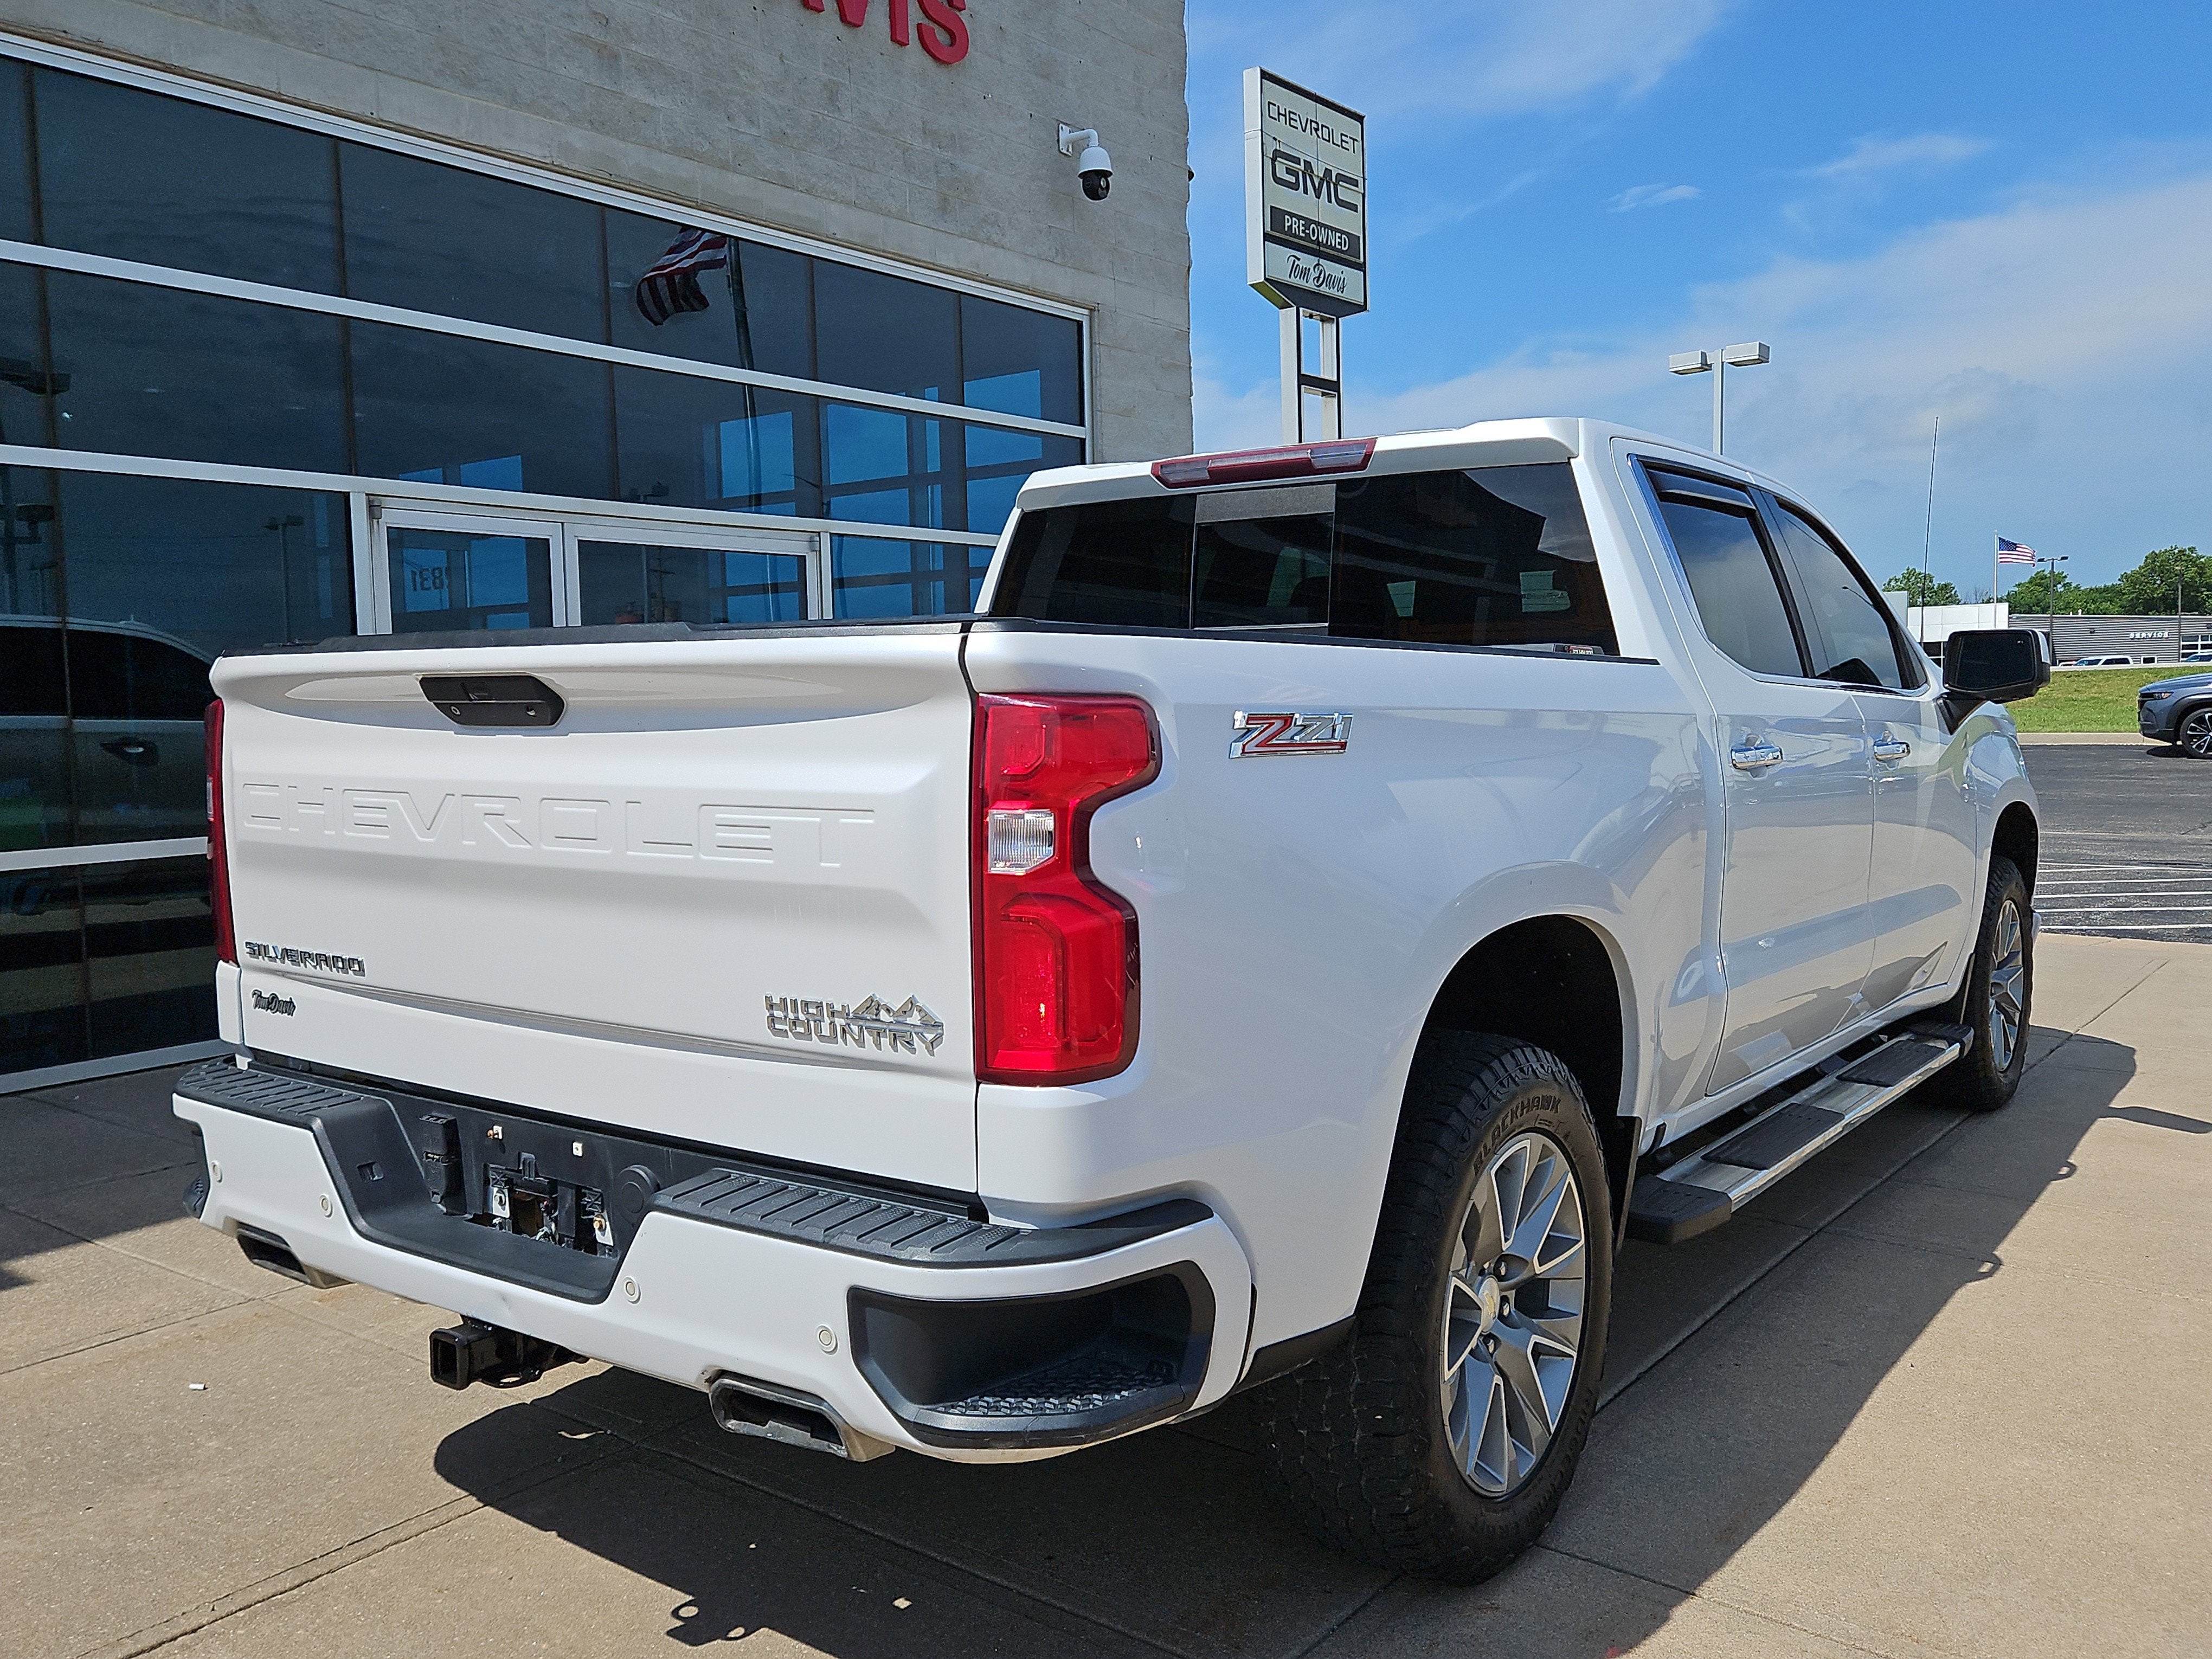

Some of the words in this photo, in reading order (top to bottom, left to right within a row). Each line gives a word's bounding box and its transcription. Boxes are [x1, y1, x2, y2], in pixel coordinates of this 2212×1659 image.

[1268, 100, 1359, 154] CHEVROLET
[1271, 149, 1359, 213] GMC
[1284, 215, 1349, 251] PRE-OWNED
[1287, 254, 1312, 282] Tom
[1313, 263, 1347, 294] Davis
[1229, 710, 1353, 758] Z71
[243, 783, 875, 866] CHEVROLET
[245, 941, 365, 976] SILVERADO
[252, 989, 270, 1012] Tom
[269, 993, 296, 1017] Davis
[764, 994, 850, 1024] HIGH
[766, 1015, 944, 1057] COUNTRY
[1472, 1094, 1561, 1176] BLACKHAWK
